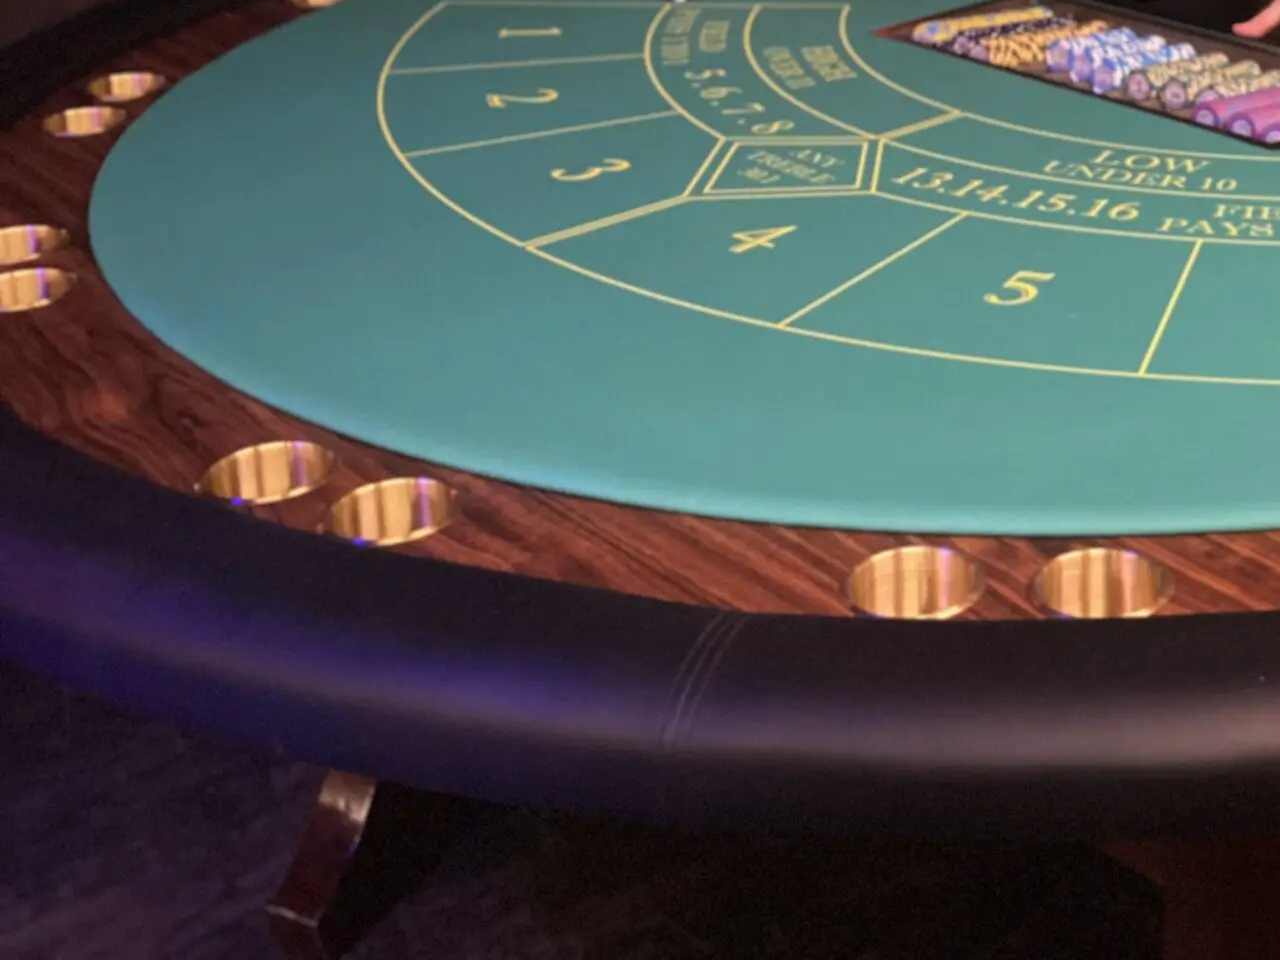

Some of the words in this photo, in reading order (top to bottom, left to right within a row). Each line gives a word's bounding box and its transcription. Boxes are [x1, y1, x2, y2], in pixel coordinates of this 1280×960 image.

[499, 25, 562, 38] 1
[486, 87, 560, 109] 2
[550, 157, 632, 182] 3
[1091, 149, 1212, 174] LOW
[1042, 159, 1188, 189] UNDER
[1200, 177, 1238, 192] 10
[729, 224, 798, 255] 4
[1155, 216, 1275, 239] PAYS
[983, 269, 1056, 307] 5
